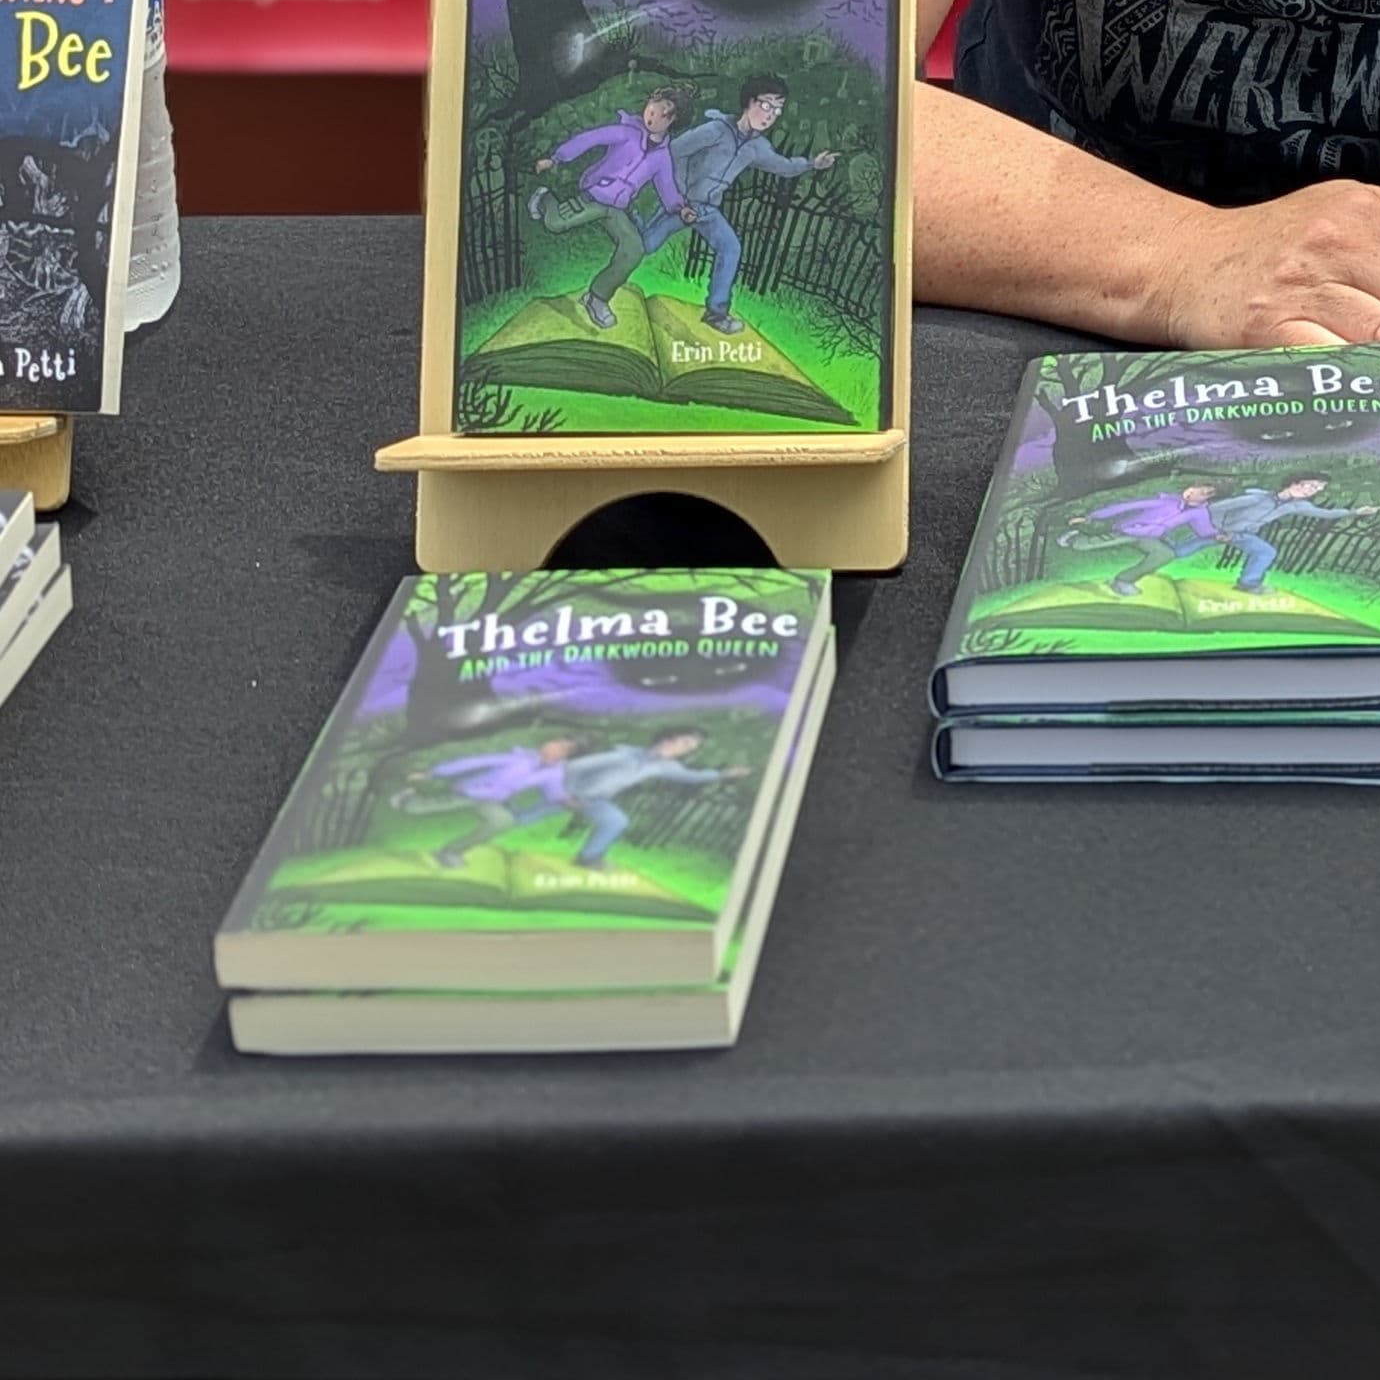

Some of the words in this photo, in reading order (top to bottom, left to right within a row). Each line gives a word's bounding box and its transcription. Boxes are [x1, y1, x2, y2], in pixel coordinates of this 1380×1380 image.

[14, 10, 112, 90] Bee
[14, 347, 76, 382] Petti
[671, 340, 713, 363] Erin
[718, 340, 762, 363] Petti
[1062, 374, 1284, 424] Thelma
[1091, 419, 1136, 443] AND
[1142, 411, 1177, 430] THE
[1186, 399, 1304, 424] DARKWOOD
[437, 605, 672, 659] Thelma
[700, 595, 800, 637] Bee
[459, 658, 511, 683] AND
[562, 640, 690, 664] DARKWOOD
[698, 637, 780, 658] QUEEN
